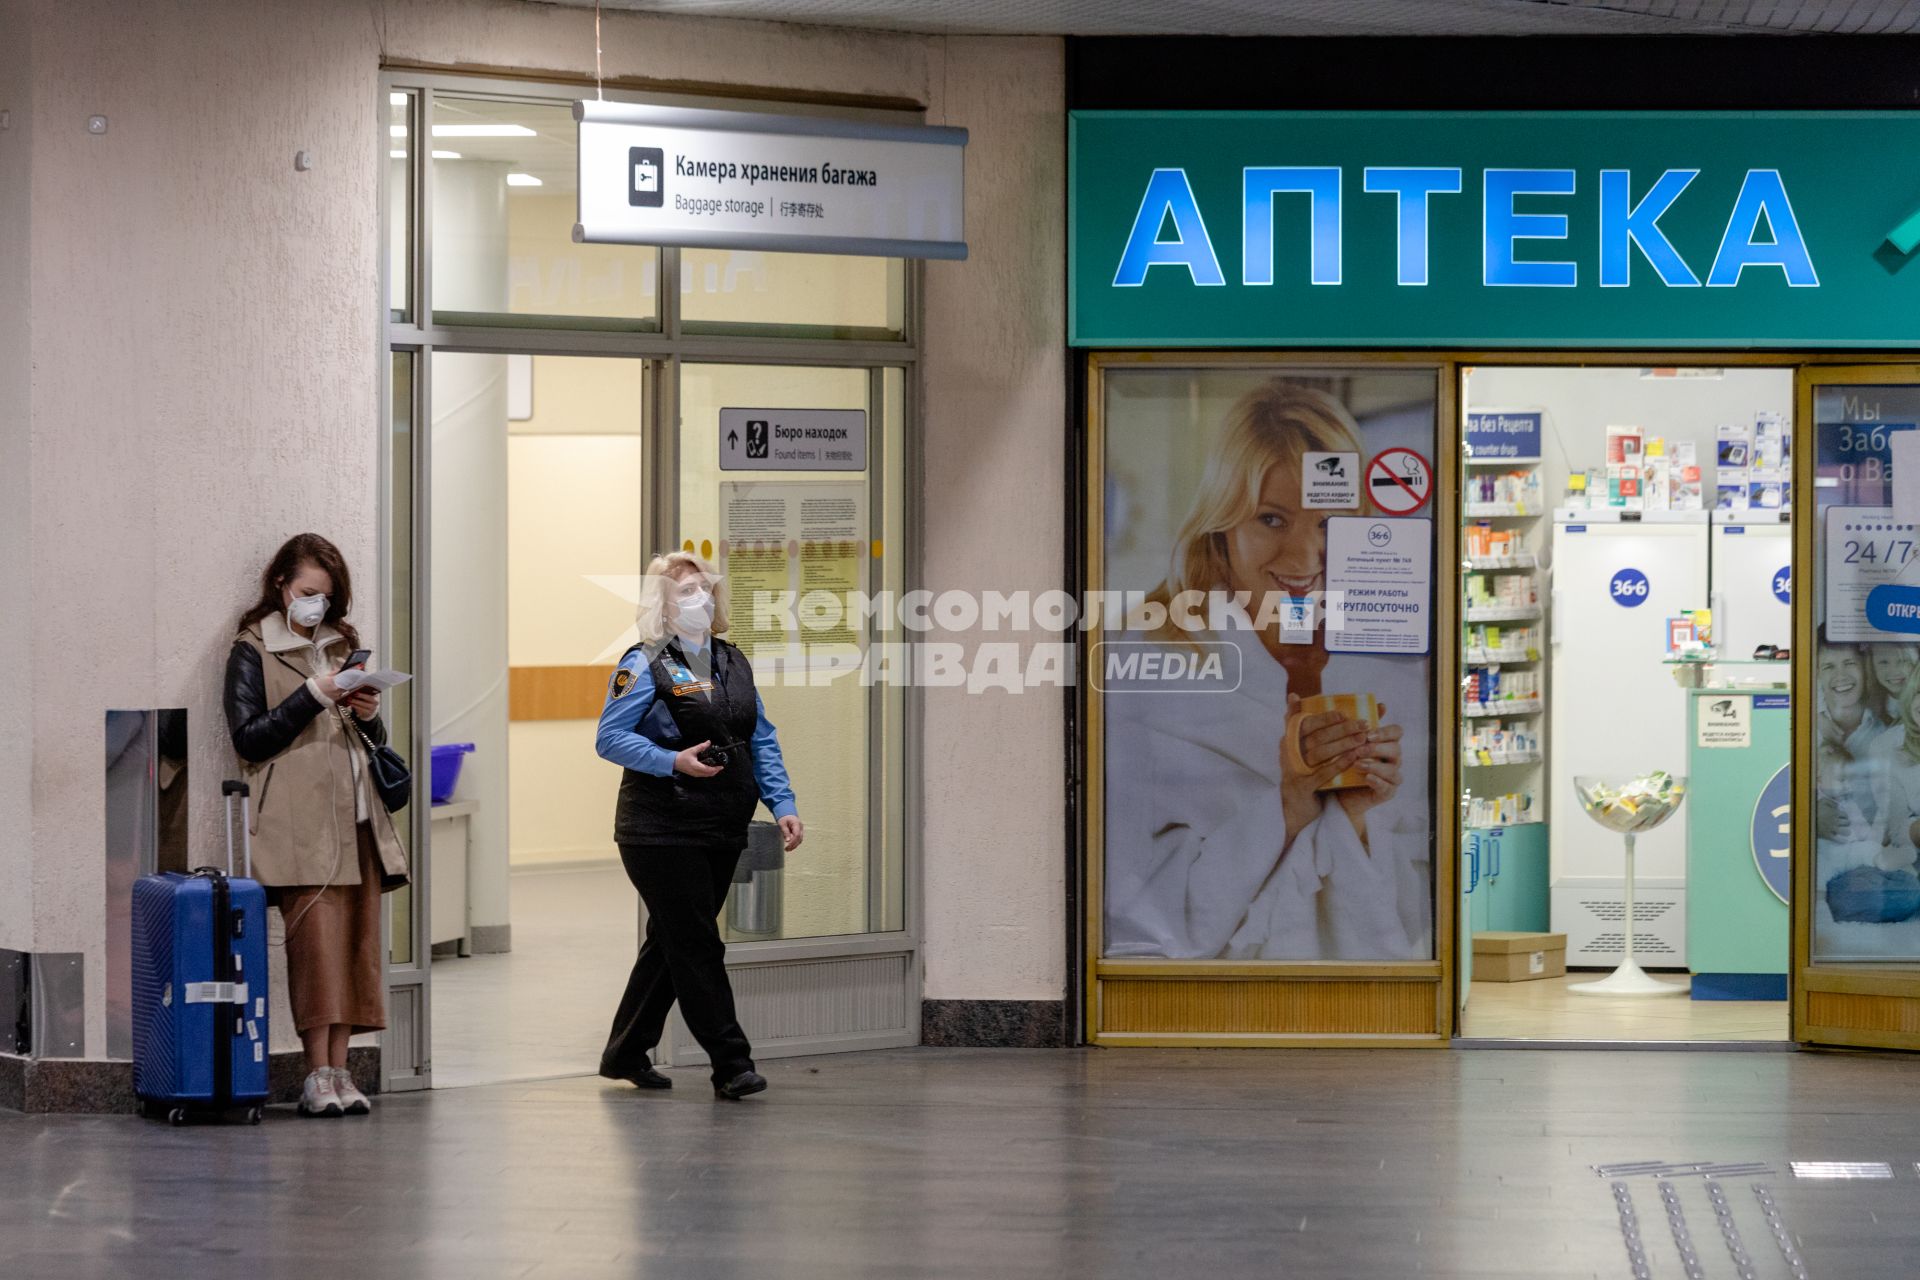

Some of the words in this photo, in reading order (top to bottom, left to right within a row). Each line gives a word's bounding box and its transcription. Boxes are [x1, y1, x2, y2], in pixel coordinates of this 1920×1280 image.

[676, 154, 737, 184] Камера
[741, 162, 818, 186] хранения
[821, 162, 877, 187] багажа
[675, 194, 722, 214] Baggage
[725, 199, 764, 218] storage
[1112, 166, 1821, 288] АПТЕКА
[1840, 395, 1880, 421] Мы
[775, 424, 803, 442] Бюро
[805, 428, 848, 442] находок
[1480, 415, 1496, 433] без
[1498, 415, 1534, 436] Рецепта
[775, 448, 796, 460] Found
[797, 449, 816, 461] items
[1348, 588, 1376, 597] РЕЖИМ
[1378, 590, 1409, 598] РАБОТЫ
[1336, 601, 1420, 613] КРУГЛОСУТОЧНО
